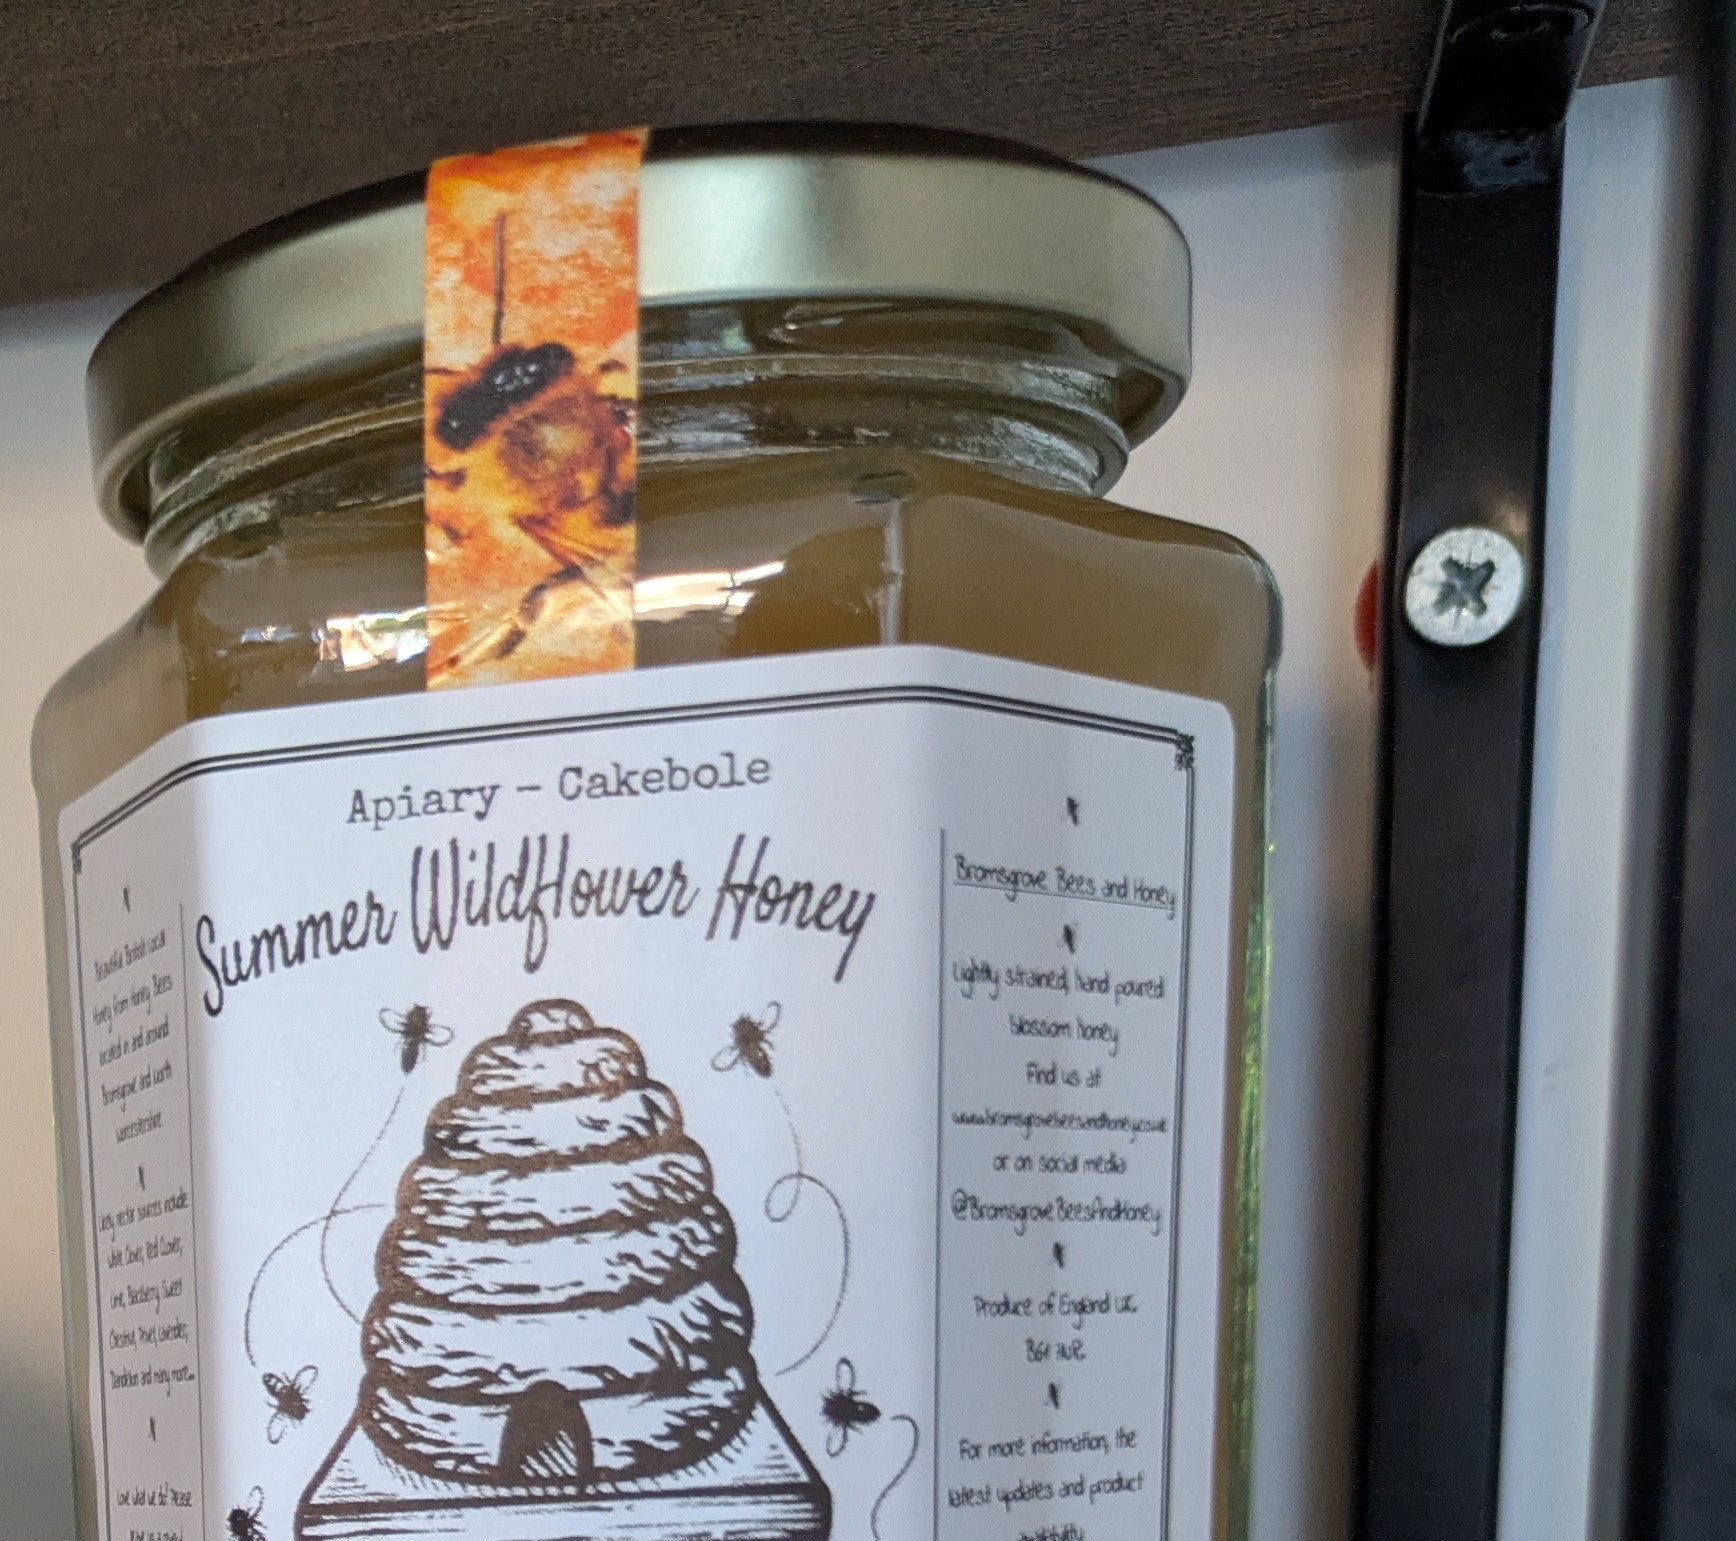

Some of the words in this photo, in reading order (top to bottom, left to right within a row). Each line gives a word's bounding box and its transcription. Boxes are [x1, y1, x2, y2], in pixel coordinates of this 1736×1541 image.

[347, 781, 500, 831] Apiary
[559, 753, 770, 802] Cakebole
[954, 853, 1047, 903] Bromsgrove
[1055, 865, 1096, 897] Bees
[1101, 875, 1128, 899] and
[1133, 878, 1175, 921] Honey
[196, 891, 398, 1018] Summer
[411, 833, 702, 974] Wildflower
[704, 834, 875, 983] Honey
[1074, 966, 1110, 993] hand
[1114, 975, 1164, 1006] poured
[1009, 1012, 1070, 1038] blossom
[1076, 1014, 1118, 1057] honey
[1026, 1061, 1058, 1085] Find
[1061, 1070, 1081, 1088] us
[1086, 1066, 1102, 1088] at
[992, 1154, 1009, 1172] or
[1014, 1154, 1032, 1172] on
[1038, 1153, 1078, 1173] social
[1082, 1150, 1127, 1175] media
[973, 1291, 1032, 1317] Produce
[1038, 1290, 1058, 1316] of
[1059, 1289, 1111, 1330] England
[958, 1438, 982, 1460] For
[988, 1438, 1024, 1458] more
[1115, 1427, 1137, 1449] the
[947, 1483, 991, 1508] latest
[996, 1478, 1053, 1514] updates
[1058, 1473, 1085, 1498] and
[1089, 1470, 1144, 1505] product
